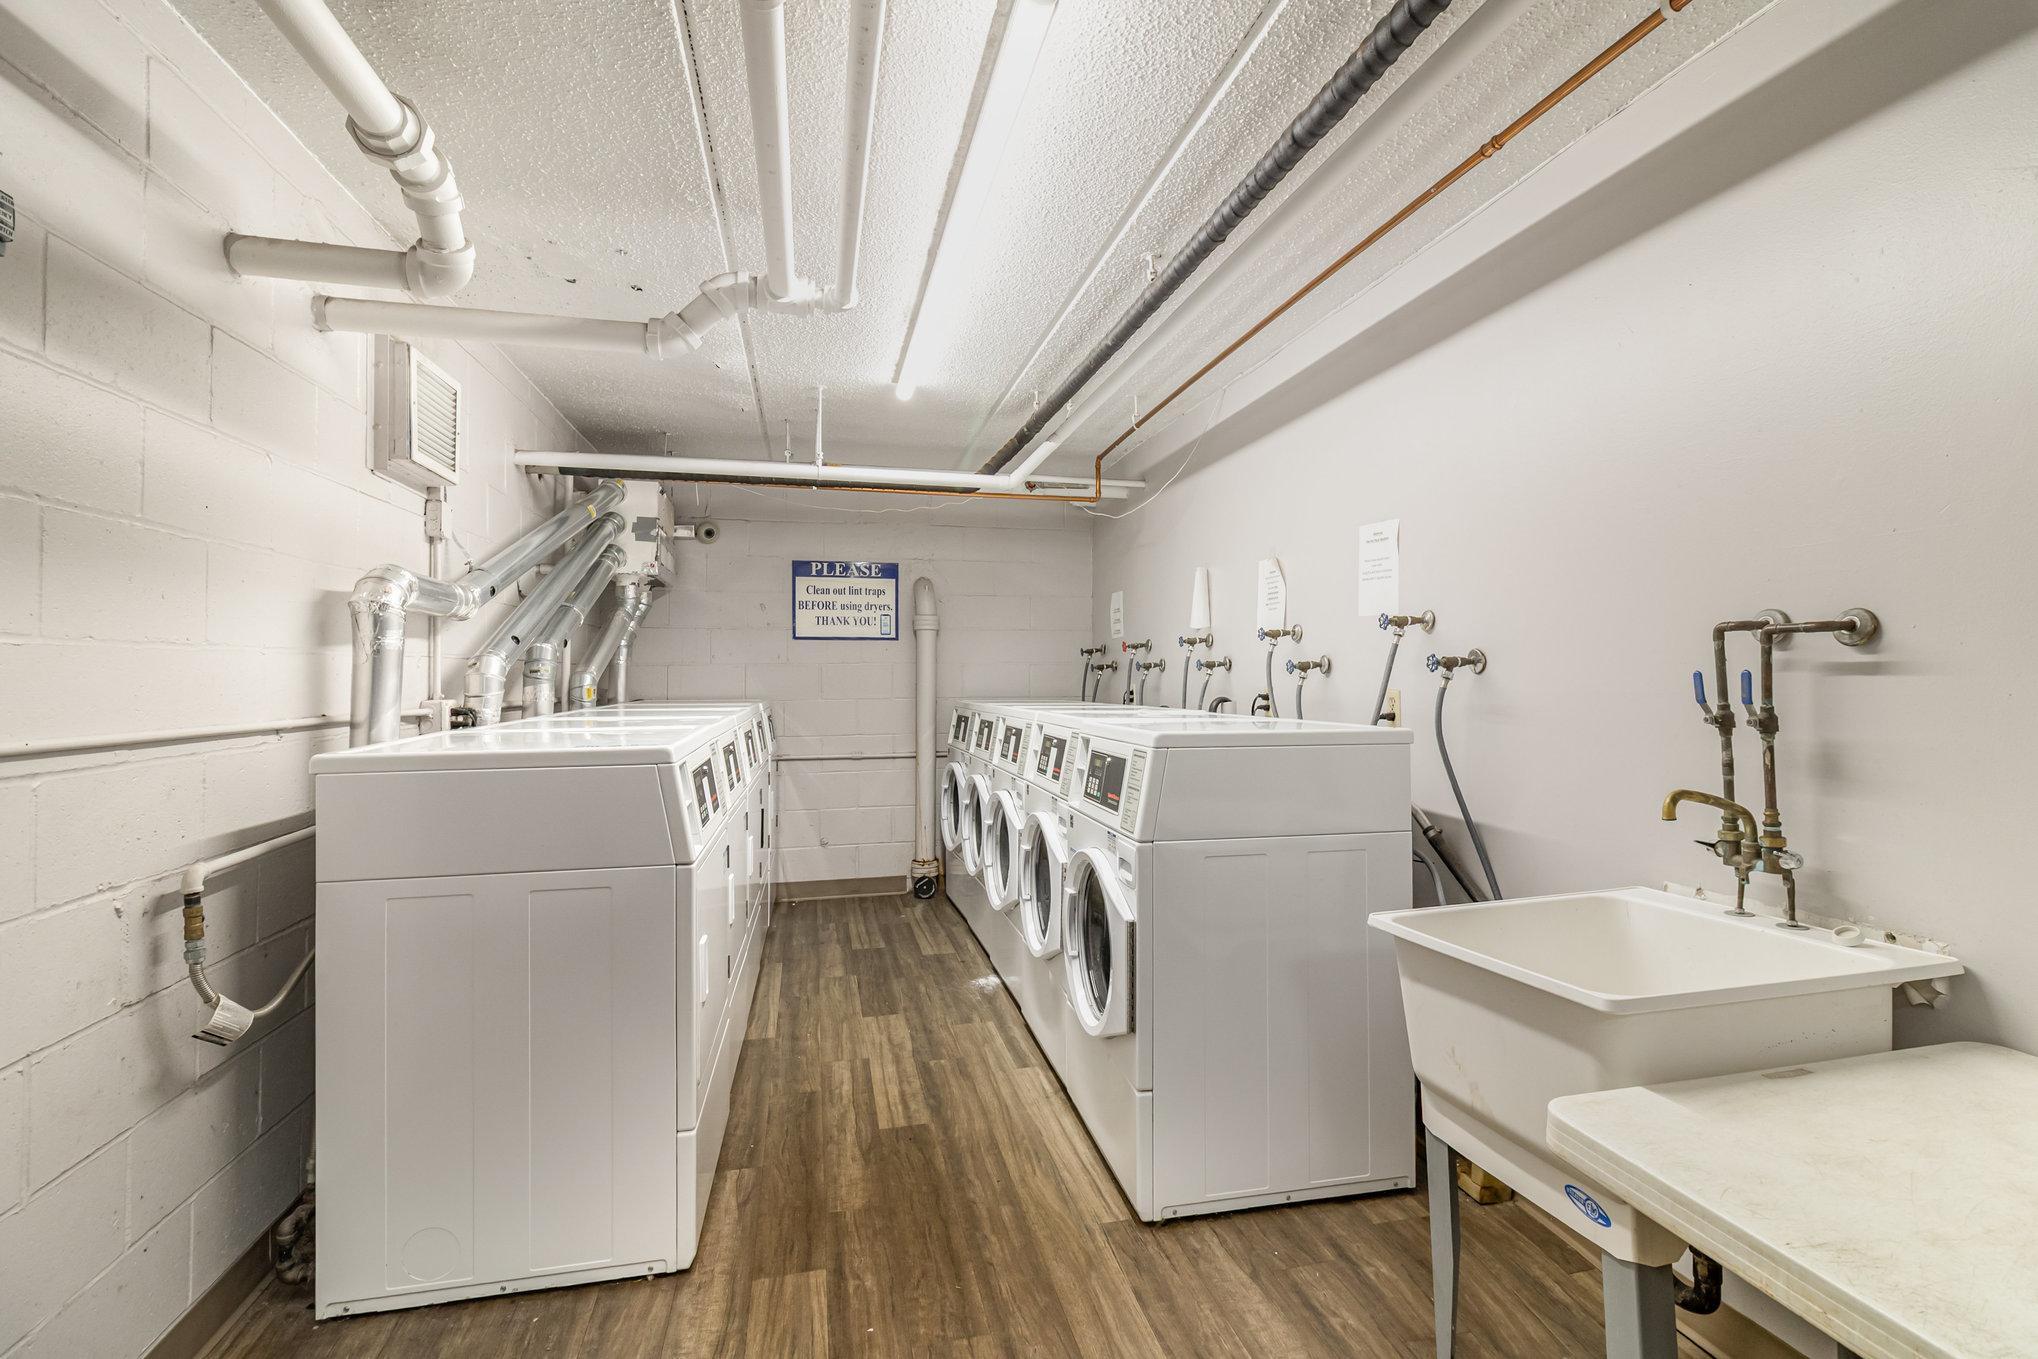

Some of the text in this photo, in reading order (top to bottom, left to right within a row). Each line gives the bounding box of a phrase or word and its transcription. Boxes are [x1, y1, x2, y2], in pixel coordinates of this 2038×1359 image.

[810, 561, 882, 577] PLEASE
[806, 585, 886, 598] Clean out lint traps
[798, 600, 893, 613] BEFORE using dryers.
[815, 616, 877, 626] THANK YOU!
